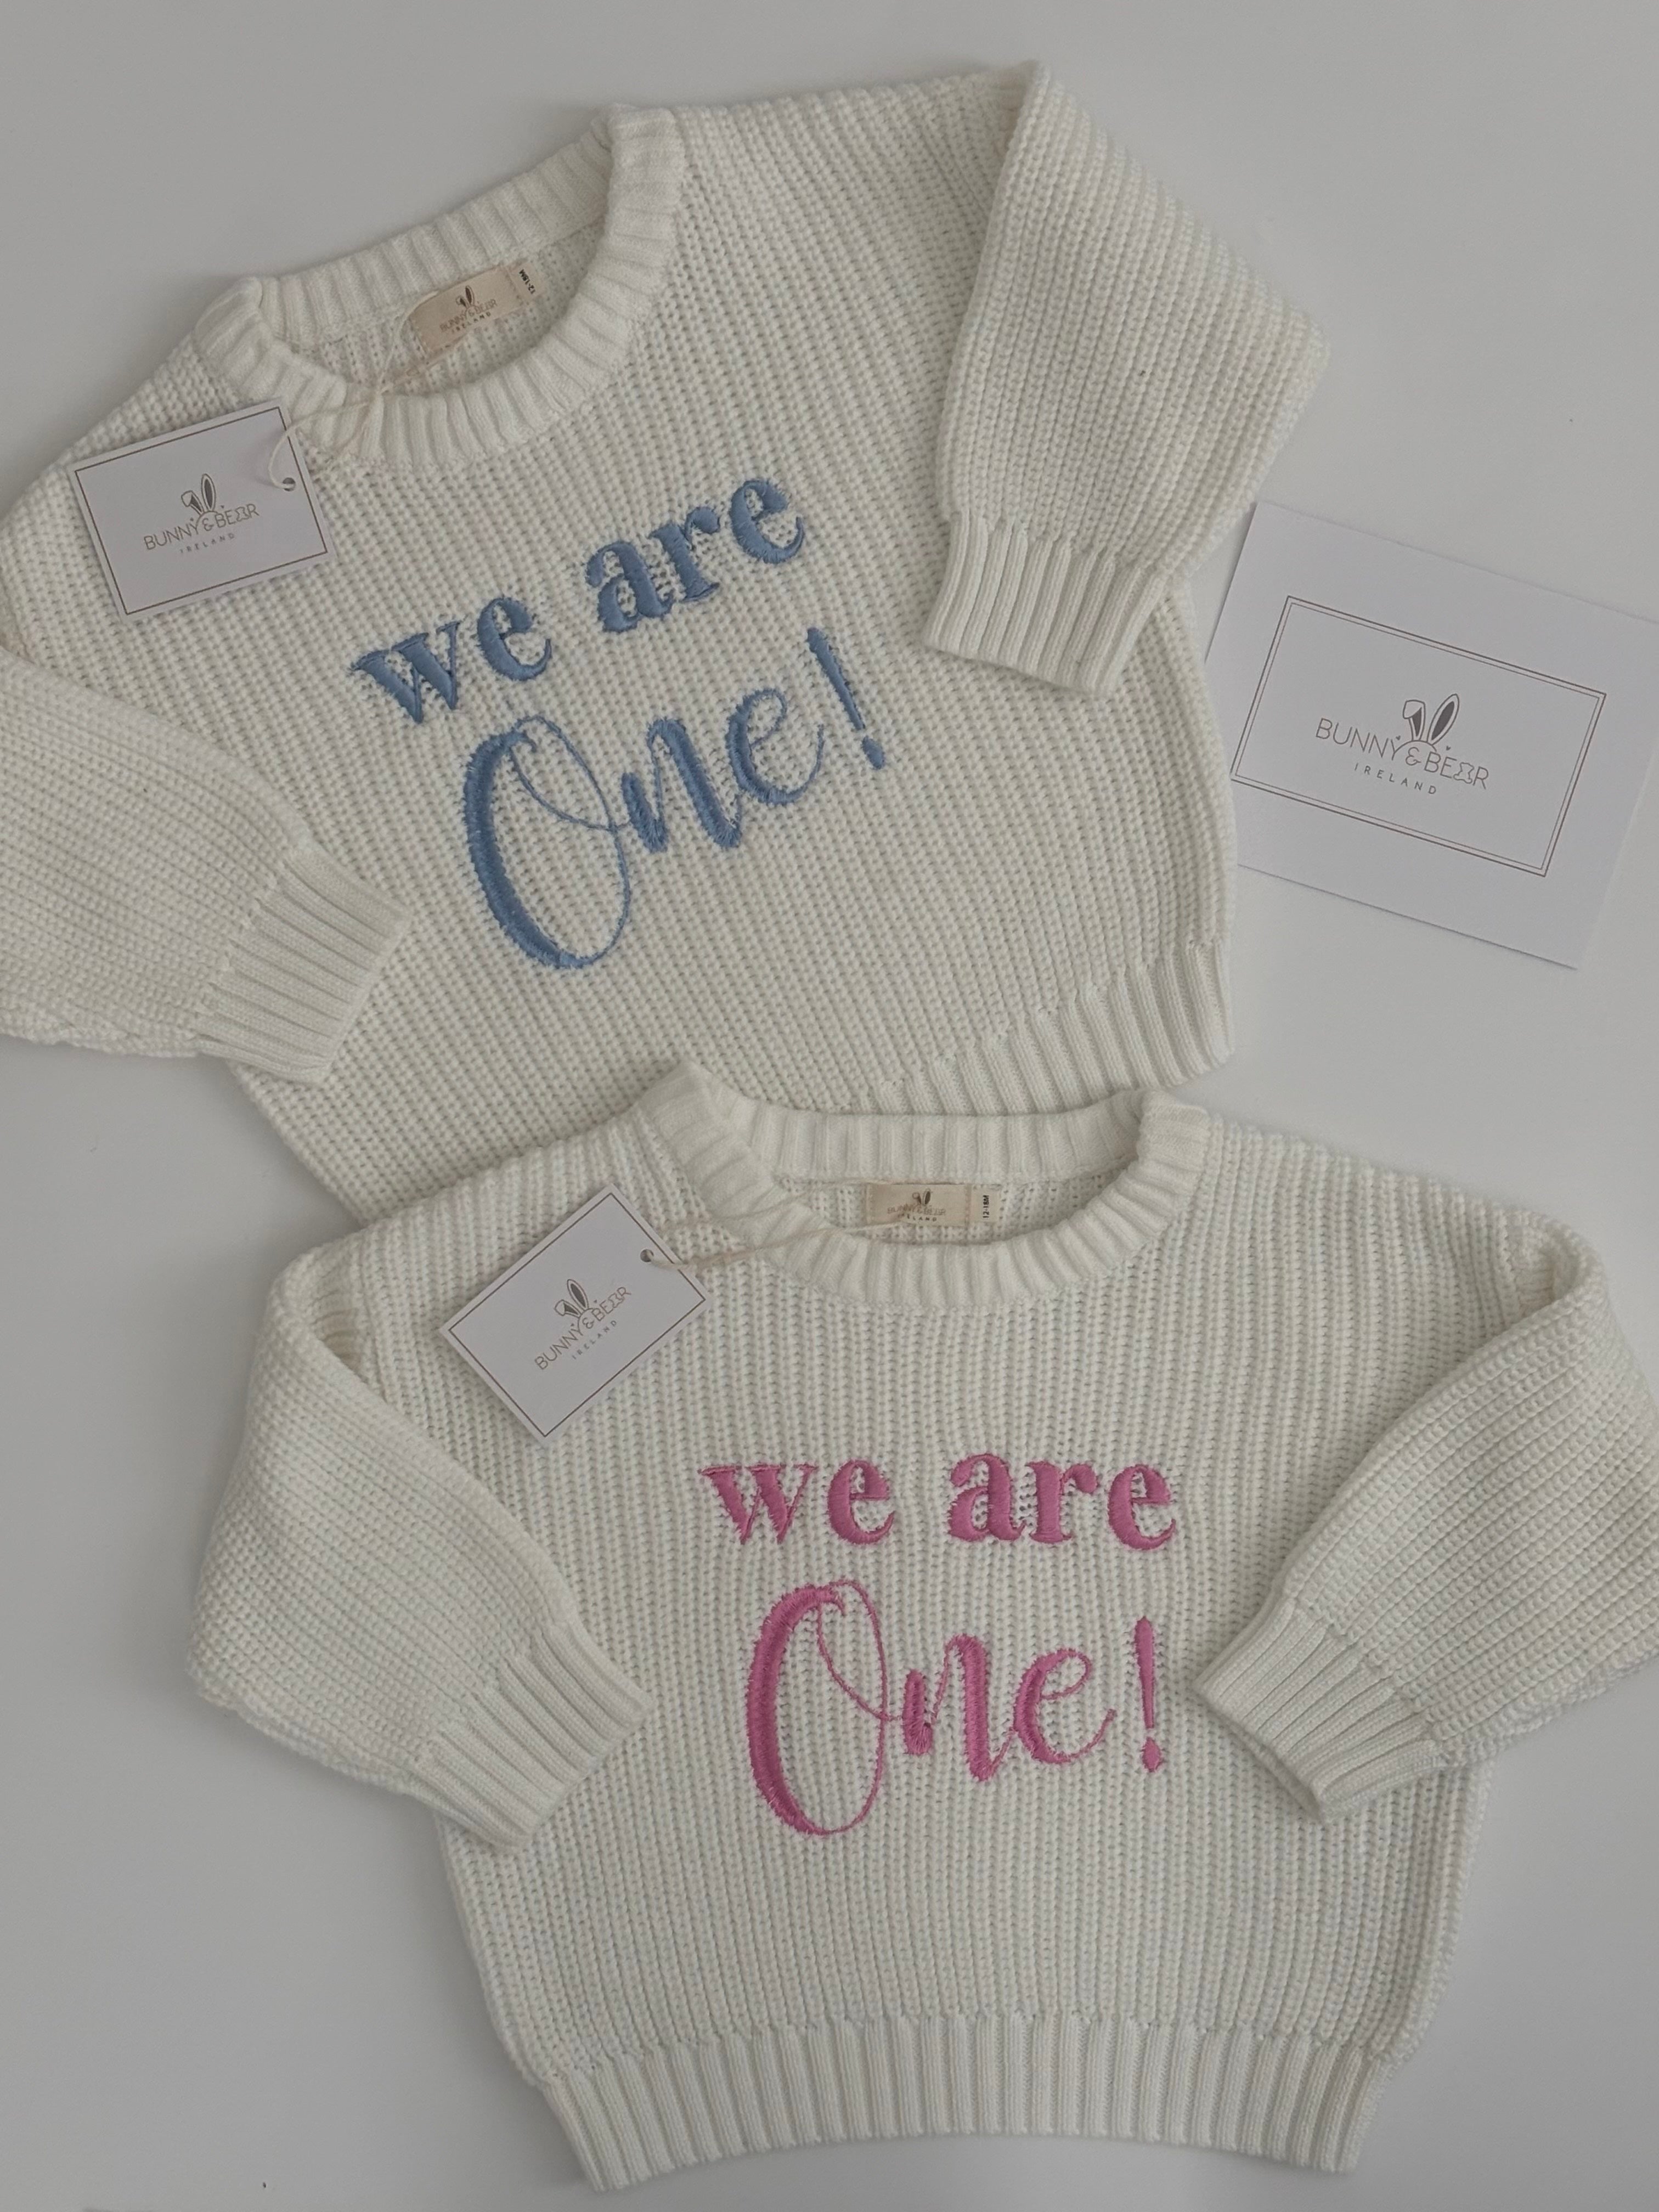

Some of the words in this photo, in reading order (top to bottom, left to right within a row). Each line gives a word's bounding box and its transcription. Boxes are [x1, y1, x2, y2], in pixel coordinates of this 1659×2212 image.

[519, 269, 535, 295] 12-18M
[143, 521, 200, 550] BUNNY
[180, 532, 236, 554] IRELAND
[349, 595, 552, 723] we
[585, 478, 805, 633] are
[1316, 718, 1400, 761] BUNNY
[463, 627, 884, 968] One!
[1354, 763, 1437, 794] IRELAND
[534, 1324, 584, 1370] BUNNY
[572, 1319, 617, 1360] IRELAND
[697, 1459, 895, 1545] we
[947, 1453, 1176, 1550] are
[744, 1576, 1163, 1837] One!
